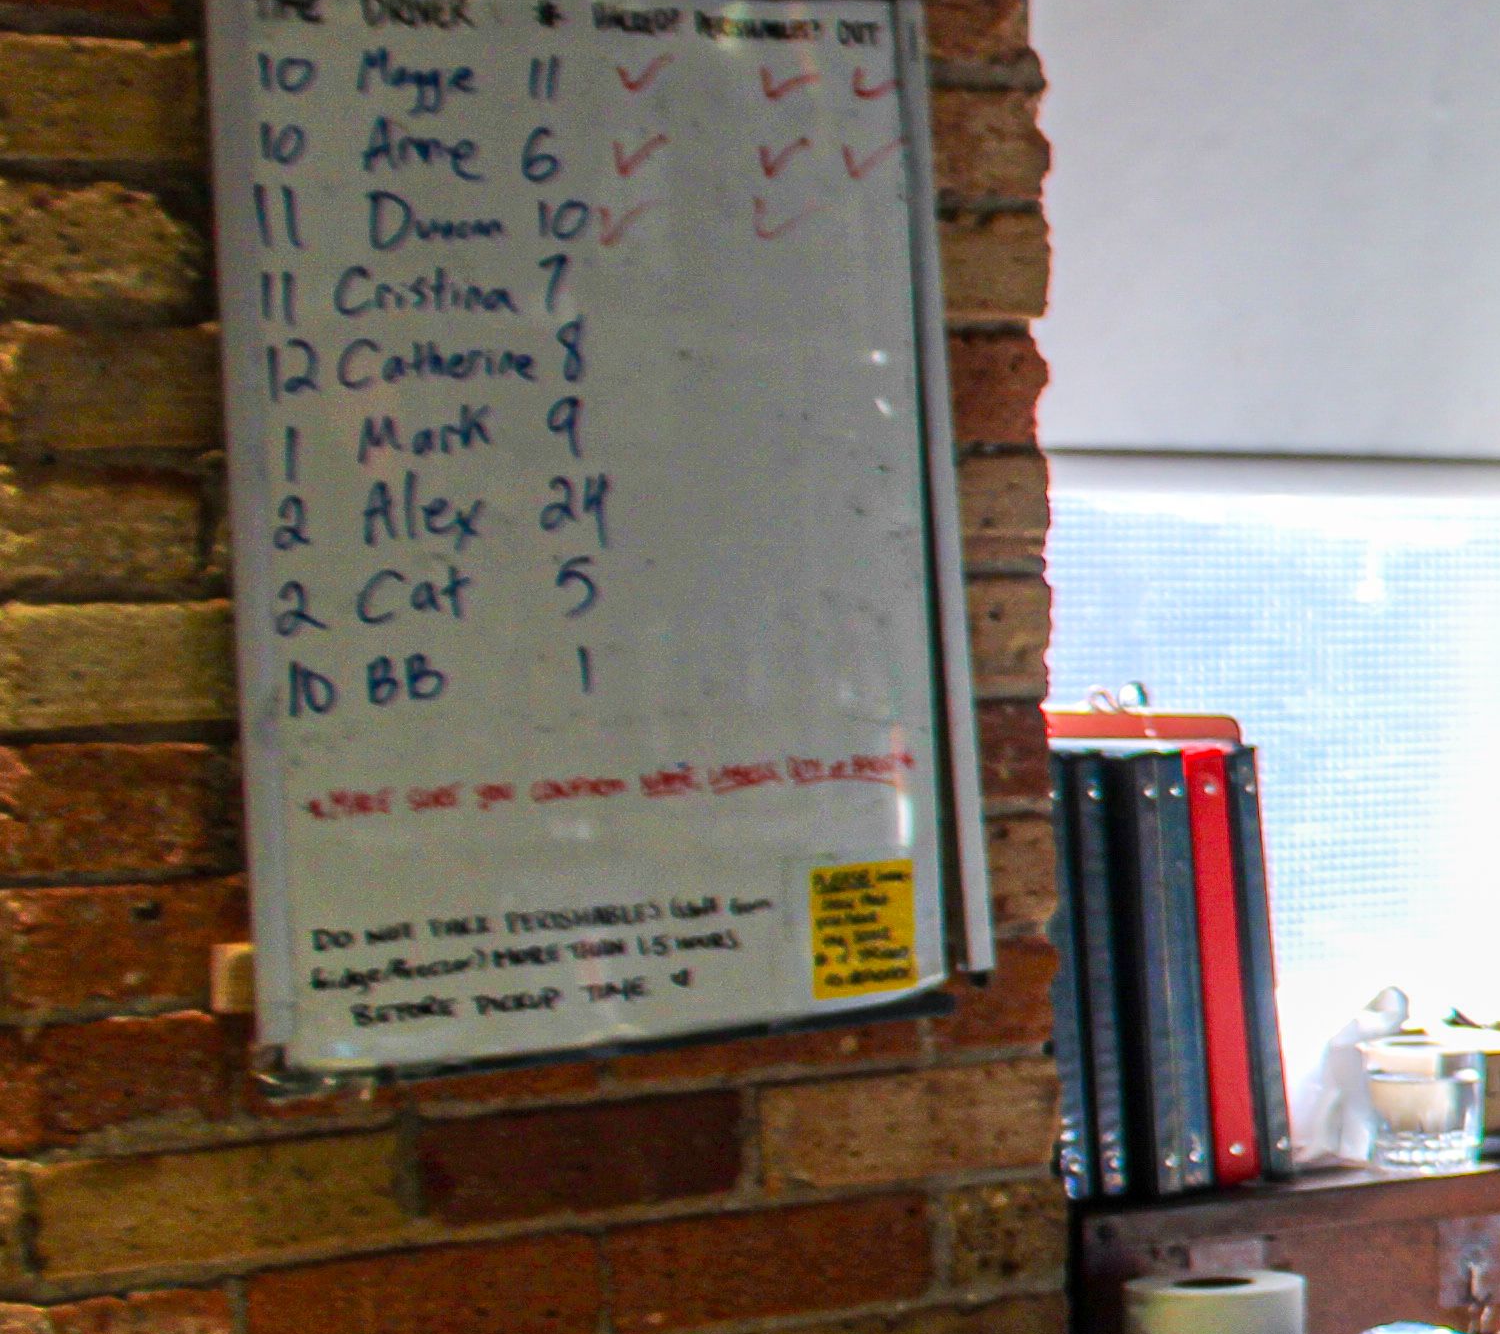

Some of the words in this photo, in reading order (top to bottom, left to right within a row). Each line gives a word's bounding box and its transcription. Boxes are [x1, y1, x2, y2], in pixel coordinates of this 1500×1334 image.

[257, 52, 316, 94] 10
[528, 54, 562, 100] 11
[259, 120, 307, 165] 10
[520, 126, 562, 183] 6
[252, 183, 304, 249] 11
[537, 198, 590, 240] 10
[260, 270, 298, 326] 11
[333, 265, 521, 317] Cristina
[538, 253, 570, 314] 7
[266, 336, 320, 403] 12
[337, 336, 538, 391] Catherine
[556, 314, 586, 382] 8
[284, 425, 298, 484] 1
[357, 403, 492, 464] Mark
[547, 395, 583, 459] 9
[273, 494, 312, 551] 2
[364, 469, 485, 553] Alex
[540, 472, 610, 550] 24
[274, 579, 328, 637] 2
[356, 565, 472, 625] Cat
[556, 555, 598, 619] 5
[289, 660, 336, 718] 10
[365, 652, 446, 707] BB
[312, 928, 354, 953] DO
